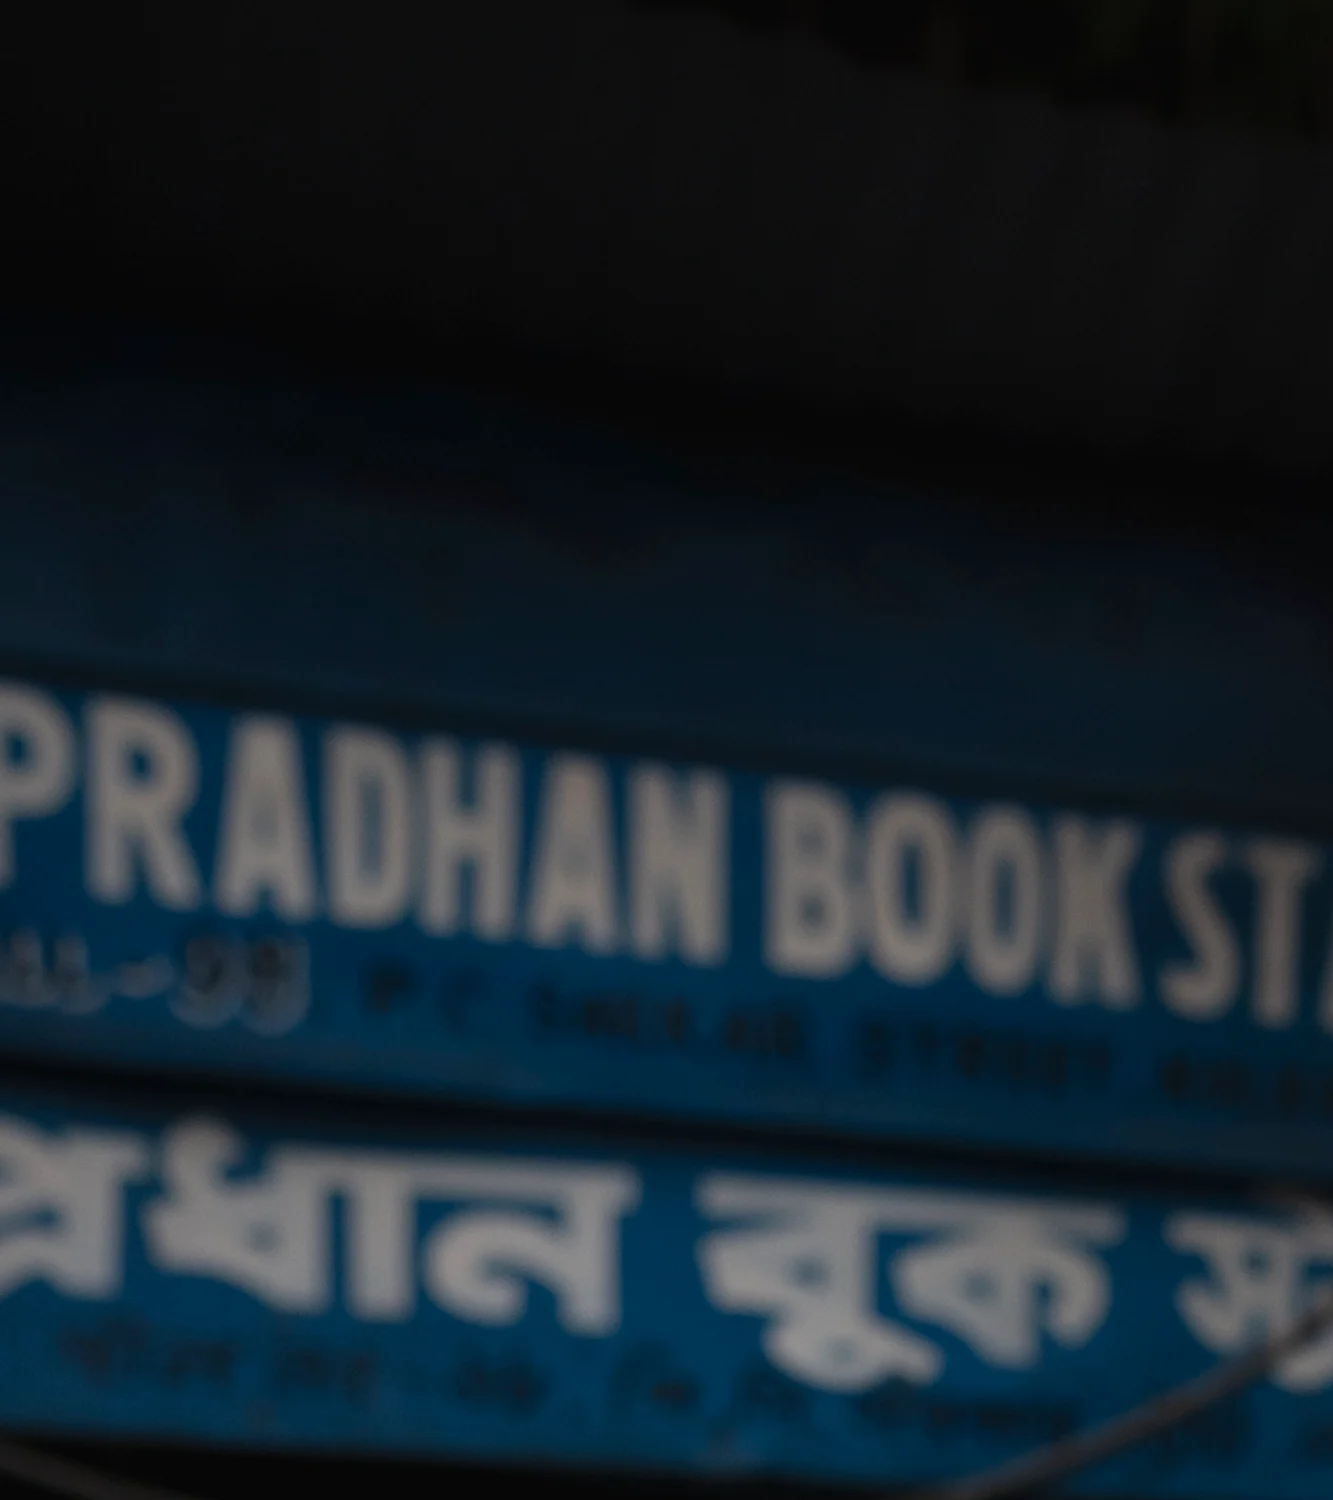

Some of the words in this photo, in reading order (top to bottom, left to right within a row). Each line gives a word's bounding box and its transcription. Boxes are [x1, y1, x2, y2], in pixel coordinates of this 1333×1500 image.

[0, 684, 728, 966] PRADHAN
[763, 780, 1142, 1008] BOOK
[0, 1115, 640, 1335] প্রধান
[696, 1172, 1127, 1391] বুক
